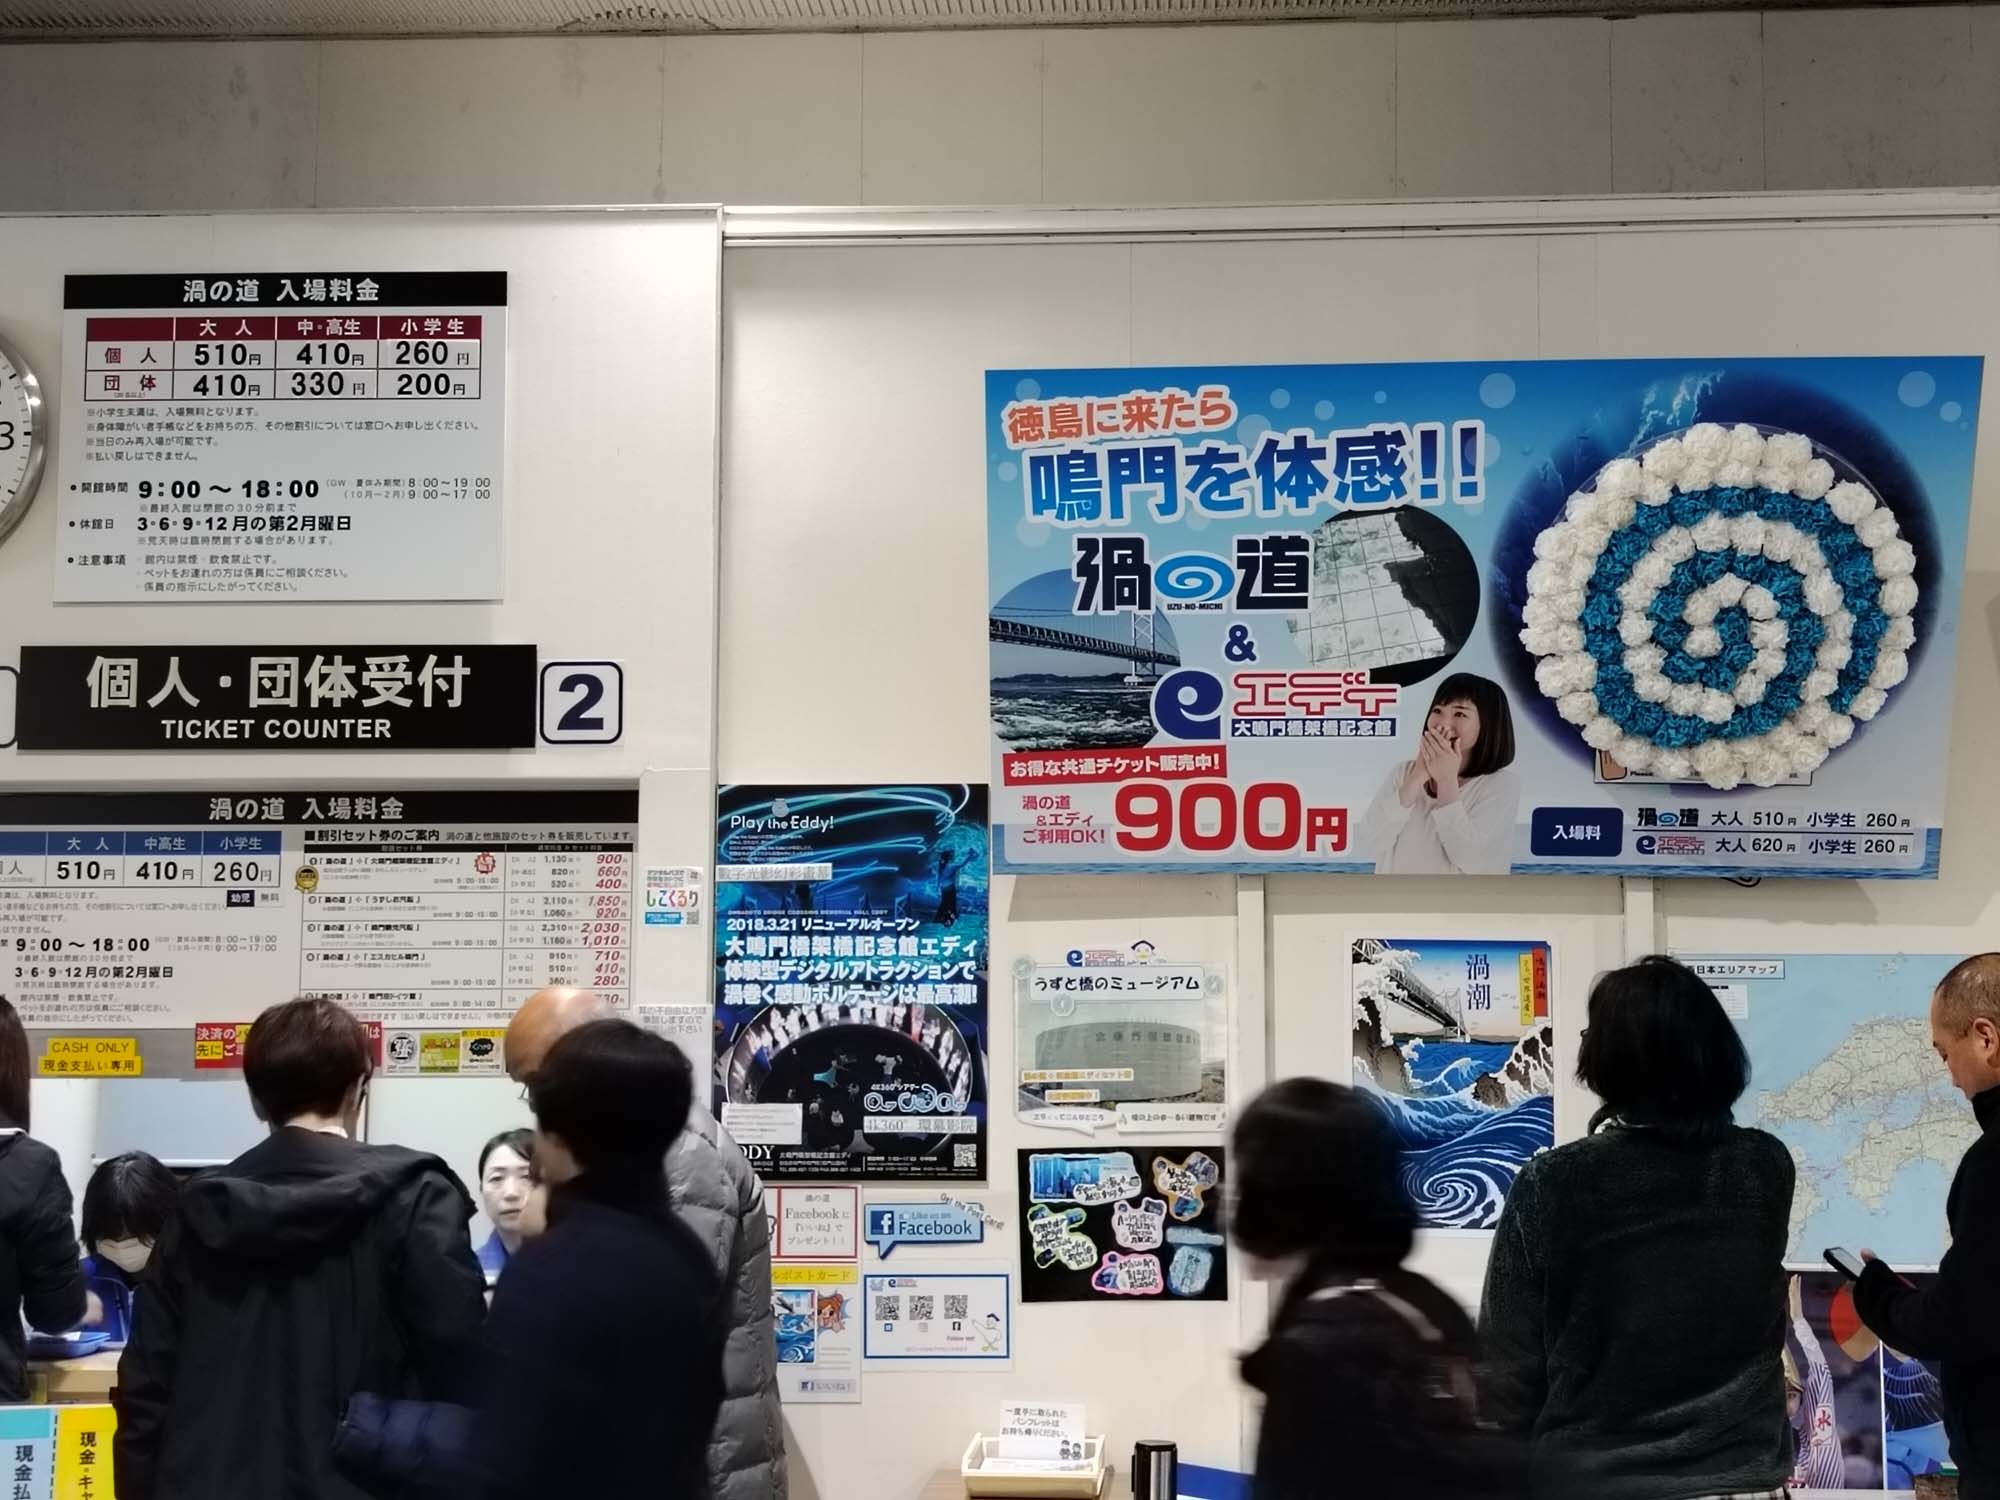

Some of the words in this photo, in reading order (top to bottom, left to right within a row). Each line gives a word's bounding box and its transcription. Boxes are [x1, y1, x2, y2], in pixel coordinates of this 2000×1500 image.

[183, 278, 261, 303] 渦の道
[275, 277, 382, 302] 入場料金
[297, 318, 362, 337] 中・高生
[400, 317, 465, 336] 小学生
[1006, 391, 1232, 444] 徳島に来たら
[1027, 427, 1479, 523] 鳴門を体感!!
[79, 519, 116, 531] 休館日
[78, 554, 127, 567] 注意事項
[85, 654, 472, 710] 個人・団体受付
[556, 673, 606, 731] 2
[161, 718, 255, 740] TICKET
[264, 717, 393, 739] COUNTER
[209, 797, 286, 821] 渦の道
[301, 796, 406, 821] 入場料金
[1021, 794, 1071, 811] 渦の道
[730, 815, 765, 832] Play
[768, 817, 788, 830] the
[791, 814, 835, 833] Eddy!
[1710, 810, 1744, 827] 大人
[1806, 811, 1856, 828] 小学生
[318, 829, 440, 843] 割引セット券のご案内
[1551, 824, 1602, 842] 入場料
[144, 836, 187, 851] 中高生
[219, 836, 263, 850] 小学生
[1714, 837, 1747, 853] 大人
[1807, 838, 1857, 855] 小学生
[727, 918, 798, 932] 2018.3.21
[801, 917, 921, 932] リニューアルオープン
[724, 935, 978, 957] 大鳴門橋架橋記念館エディ
[724, 960, 977, 981] 体験型デジタルアトラクションで
[1034, 976, 1200, 992] うずと橋のミュージアム
[1465, 953, 1491, 1012] 渦潮
[51, 1042, 90, 1054] CASH
[95, 1041, 131, 1054] ONLY
[43, 1059, 135, 1073] 現金支払い専用
[899, 1220, 974, 1236] Facebook
